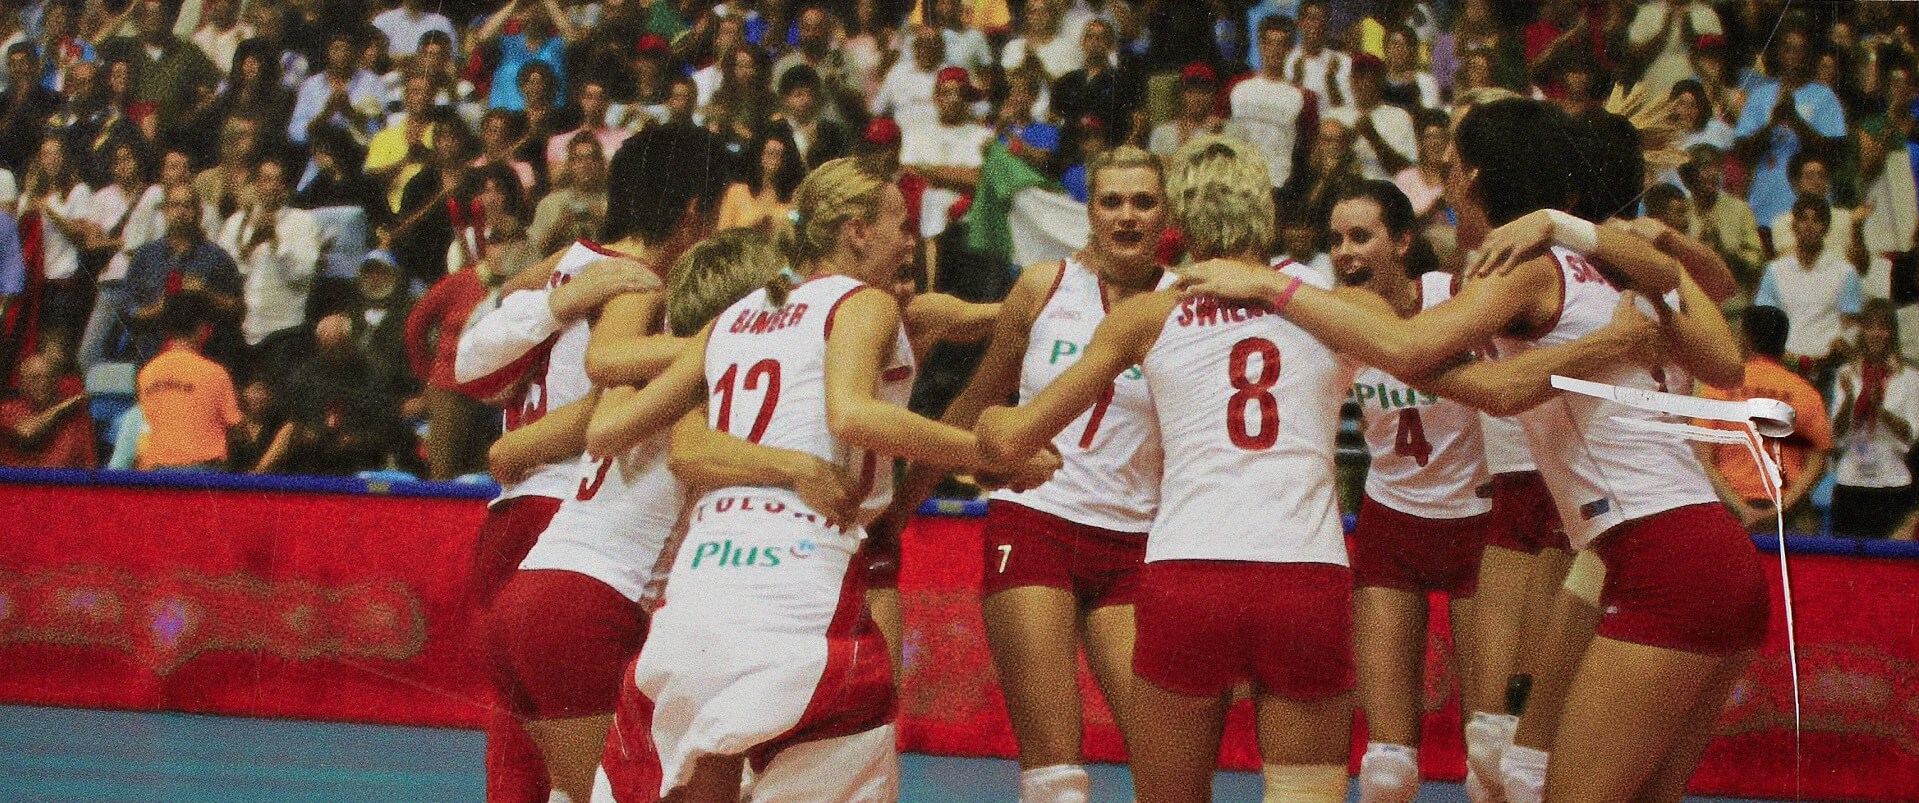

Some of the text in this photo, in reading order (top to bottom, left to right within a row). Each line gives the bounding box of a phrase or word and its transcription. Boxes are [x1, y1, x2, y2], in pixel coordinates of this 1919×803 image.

[713, 358, 781, 444] 12
[1227, 336, 1281, 451] 8
[1394, 407, 1433, 468] 4
[690, 538, 781, 570] Plus
[997, 544, 1012, 574] 7
